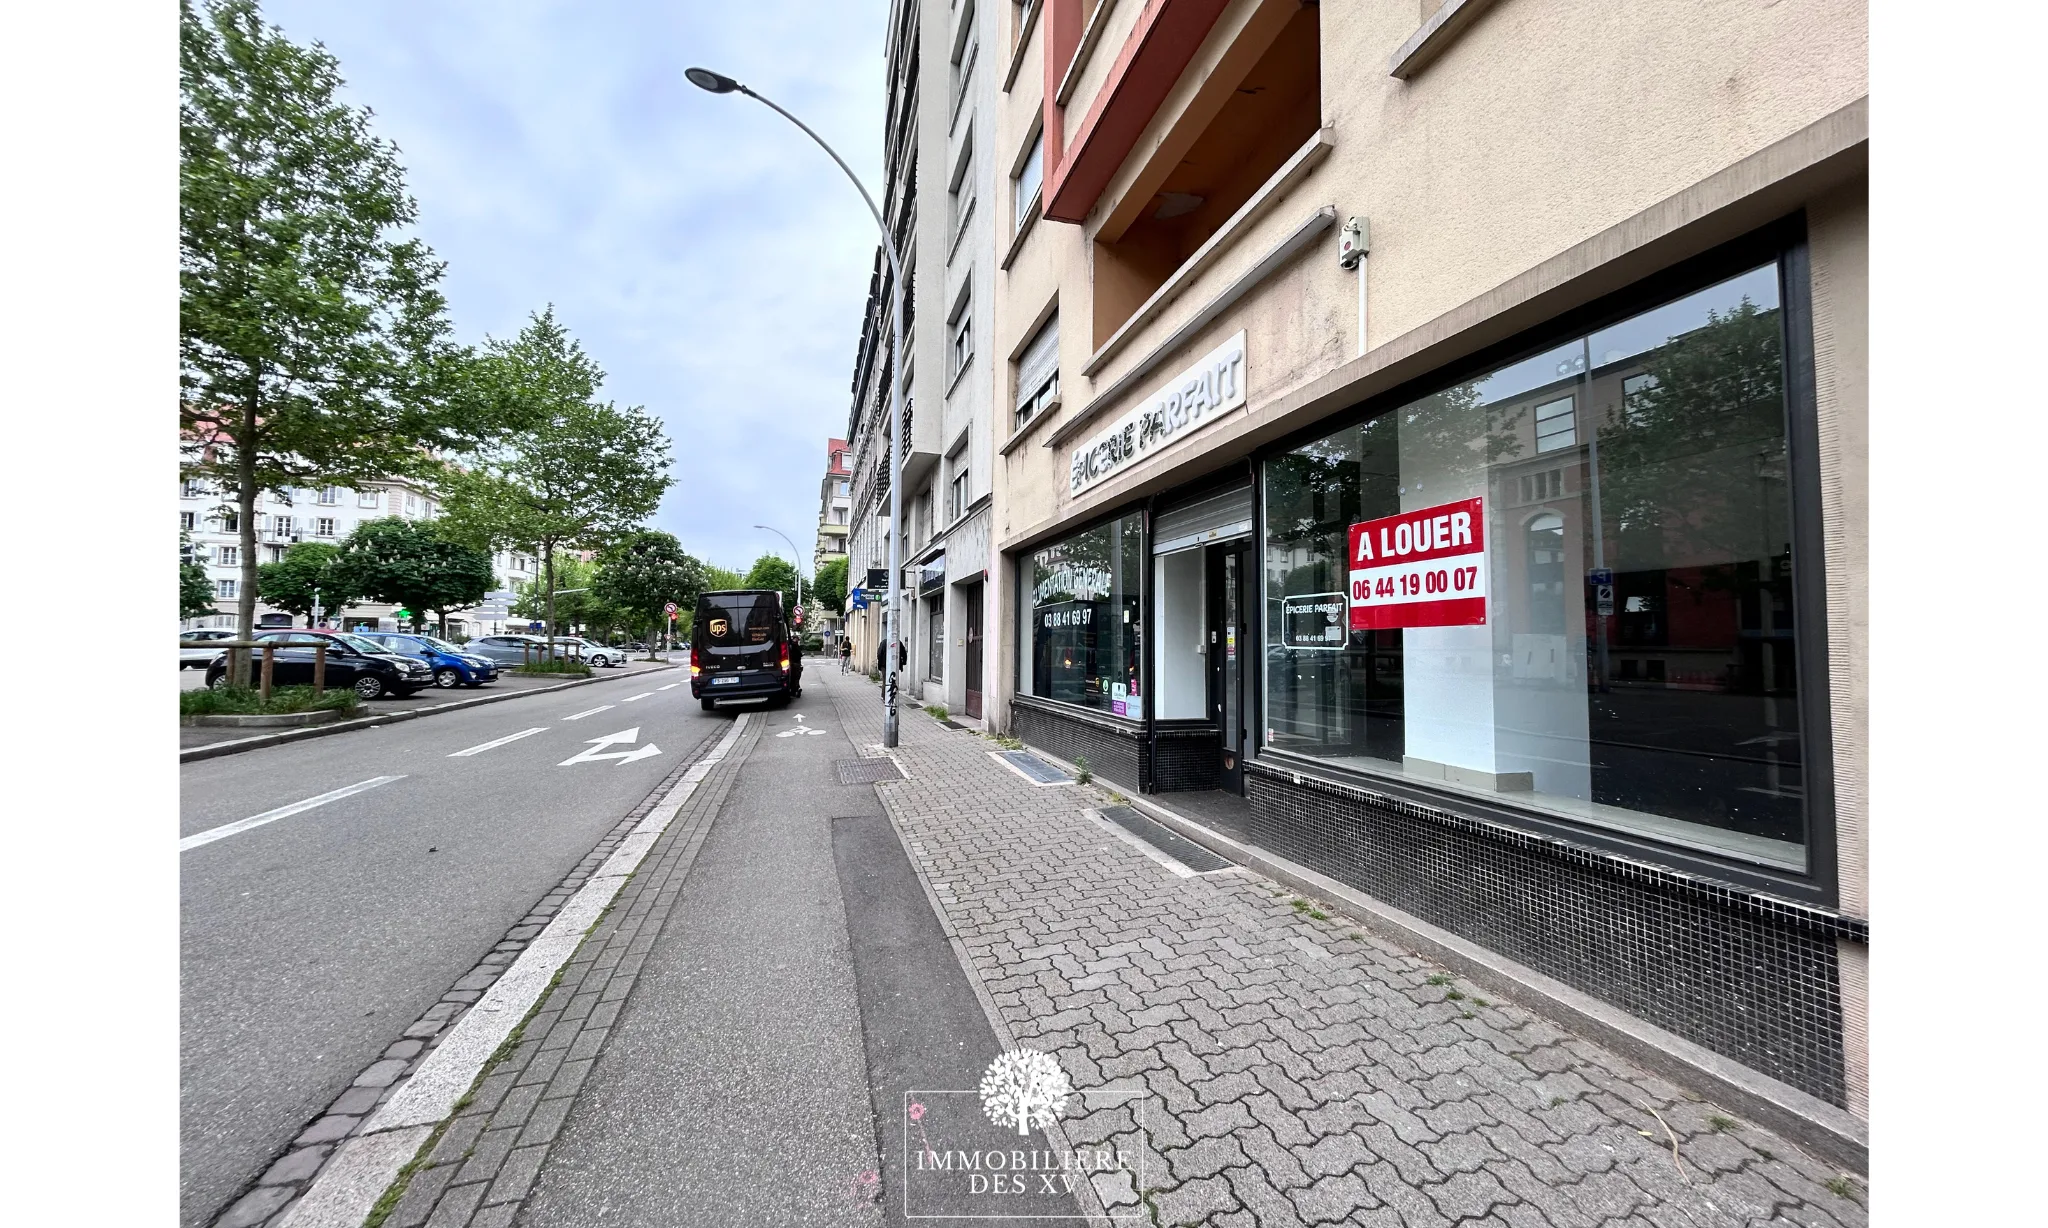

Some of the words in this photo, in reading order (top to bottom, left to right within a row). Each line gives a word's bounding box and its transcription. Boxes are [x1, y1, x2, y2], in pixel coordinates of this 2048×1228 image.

[1072, 421, 1136, 490] ÉPICERIE
[1139, 349, 1243, 450] PARFAIT
[1357, 531, 1375, 562] A
[1380, 511, 1473, 558] LOUER
[1353, 579, 1371, 601] 06
[1375, 576, 1395, 598] 44
[1400, 573, 1420, 596] 19
[1425, 569, 1448, 594] 00
[1453, 565, 1478, 591] 07
[1044, 613, 1052, 628] 03
[1053, 612, 1061, 627] 88
[1062, 610, 1070, 626] 41
[1071, 609, 1080, 626] 69
[1082, 608, 1092, 625] 97
[1286, 603, 1313, 614] ÉPICERIE
[1314, 602, 1343, 614] PARFAIT
[711, 623, 726, 635] ups
